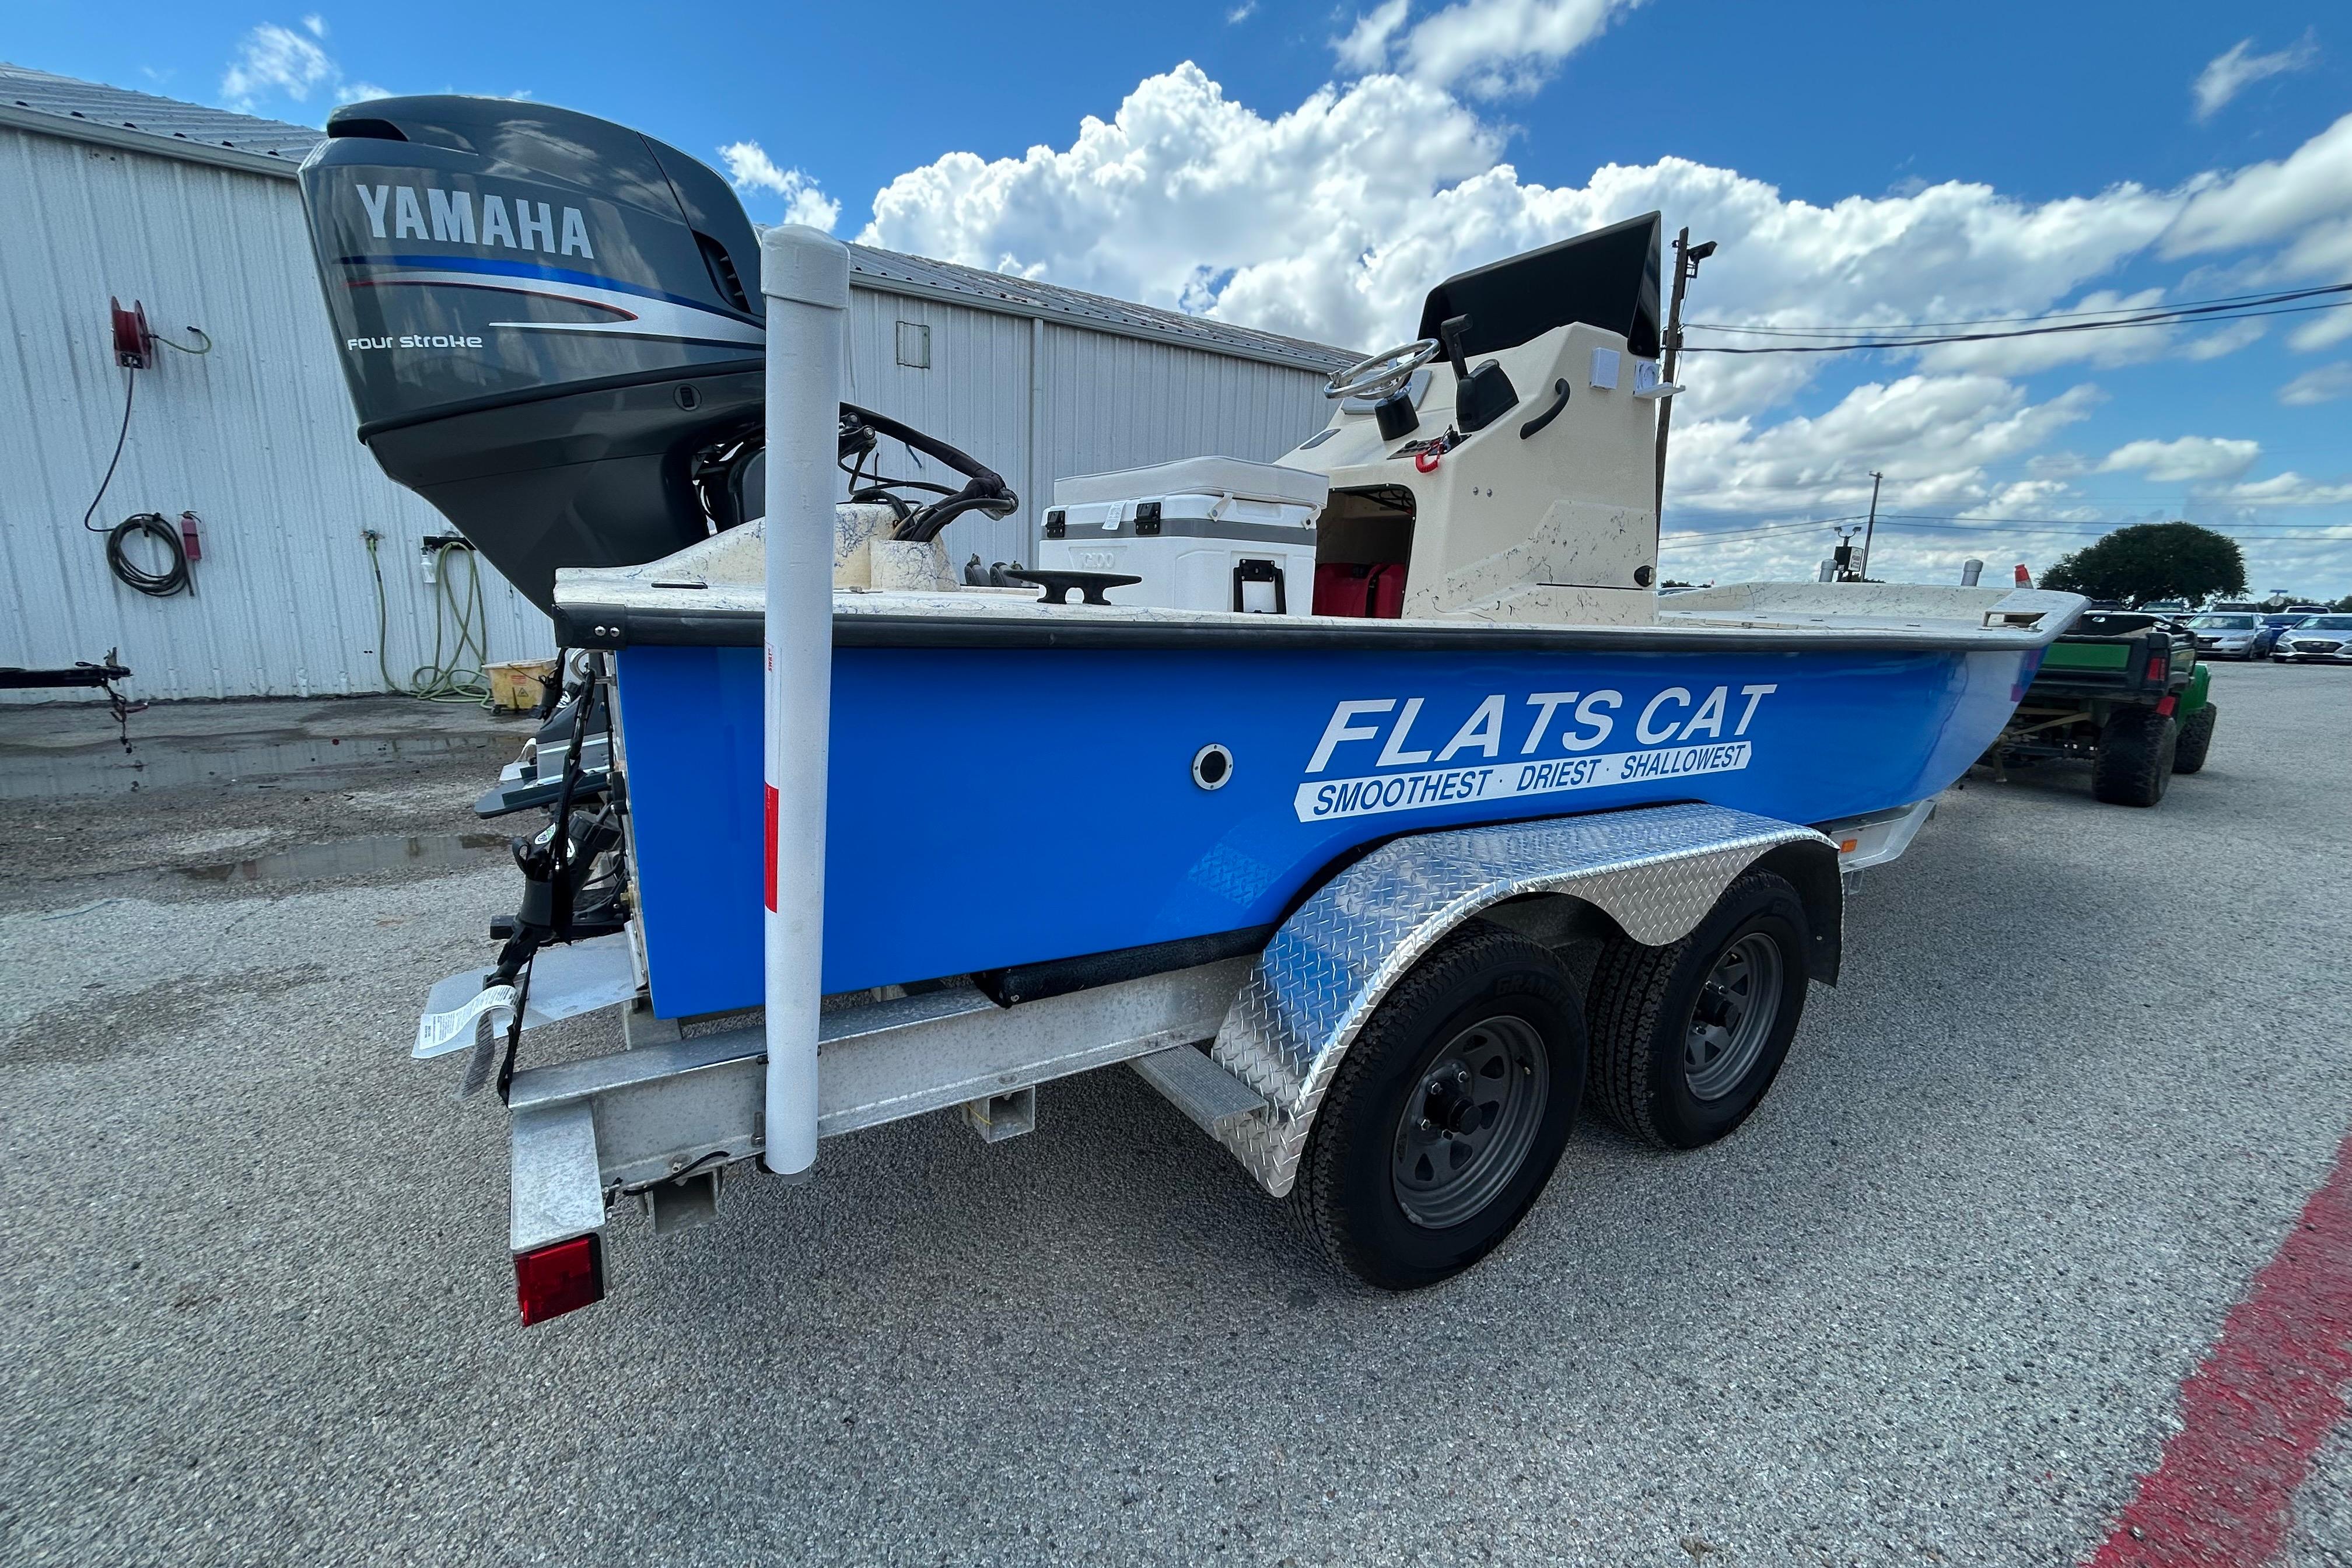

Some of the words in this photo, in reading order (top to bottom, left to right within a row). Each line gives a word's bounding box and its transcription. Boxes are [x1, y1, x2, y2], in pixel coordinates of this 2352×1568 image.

[356, 184, 594, 259] YAMAHA
[1304, 690, 1623, 773] FLATS
[1636, 684, 1777, 745] CAT
[1313, 769, 1494, 816] SMOOTHEST
[1516, 758, 1602, 792] DRIEST
[1620, 744, 1746, 780] SHALLOWEST
